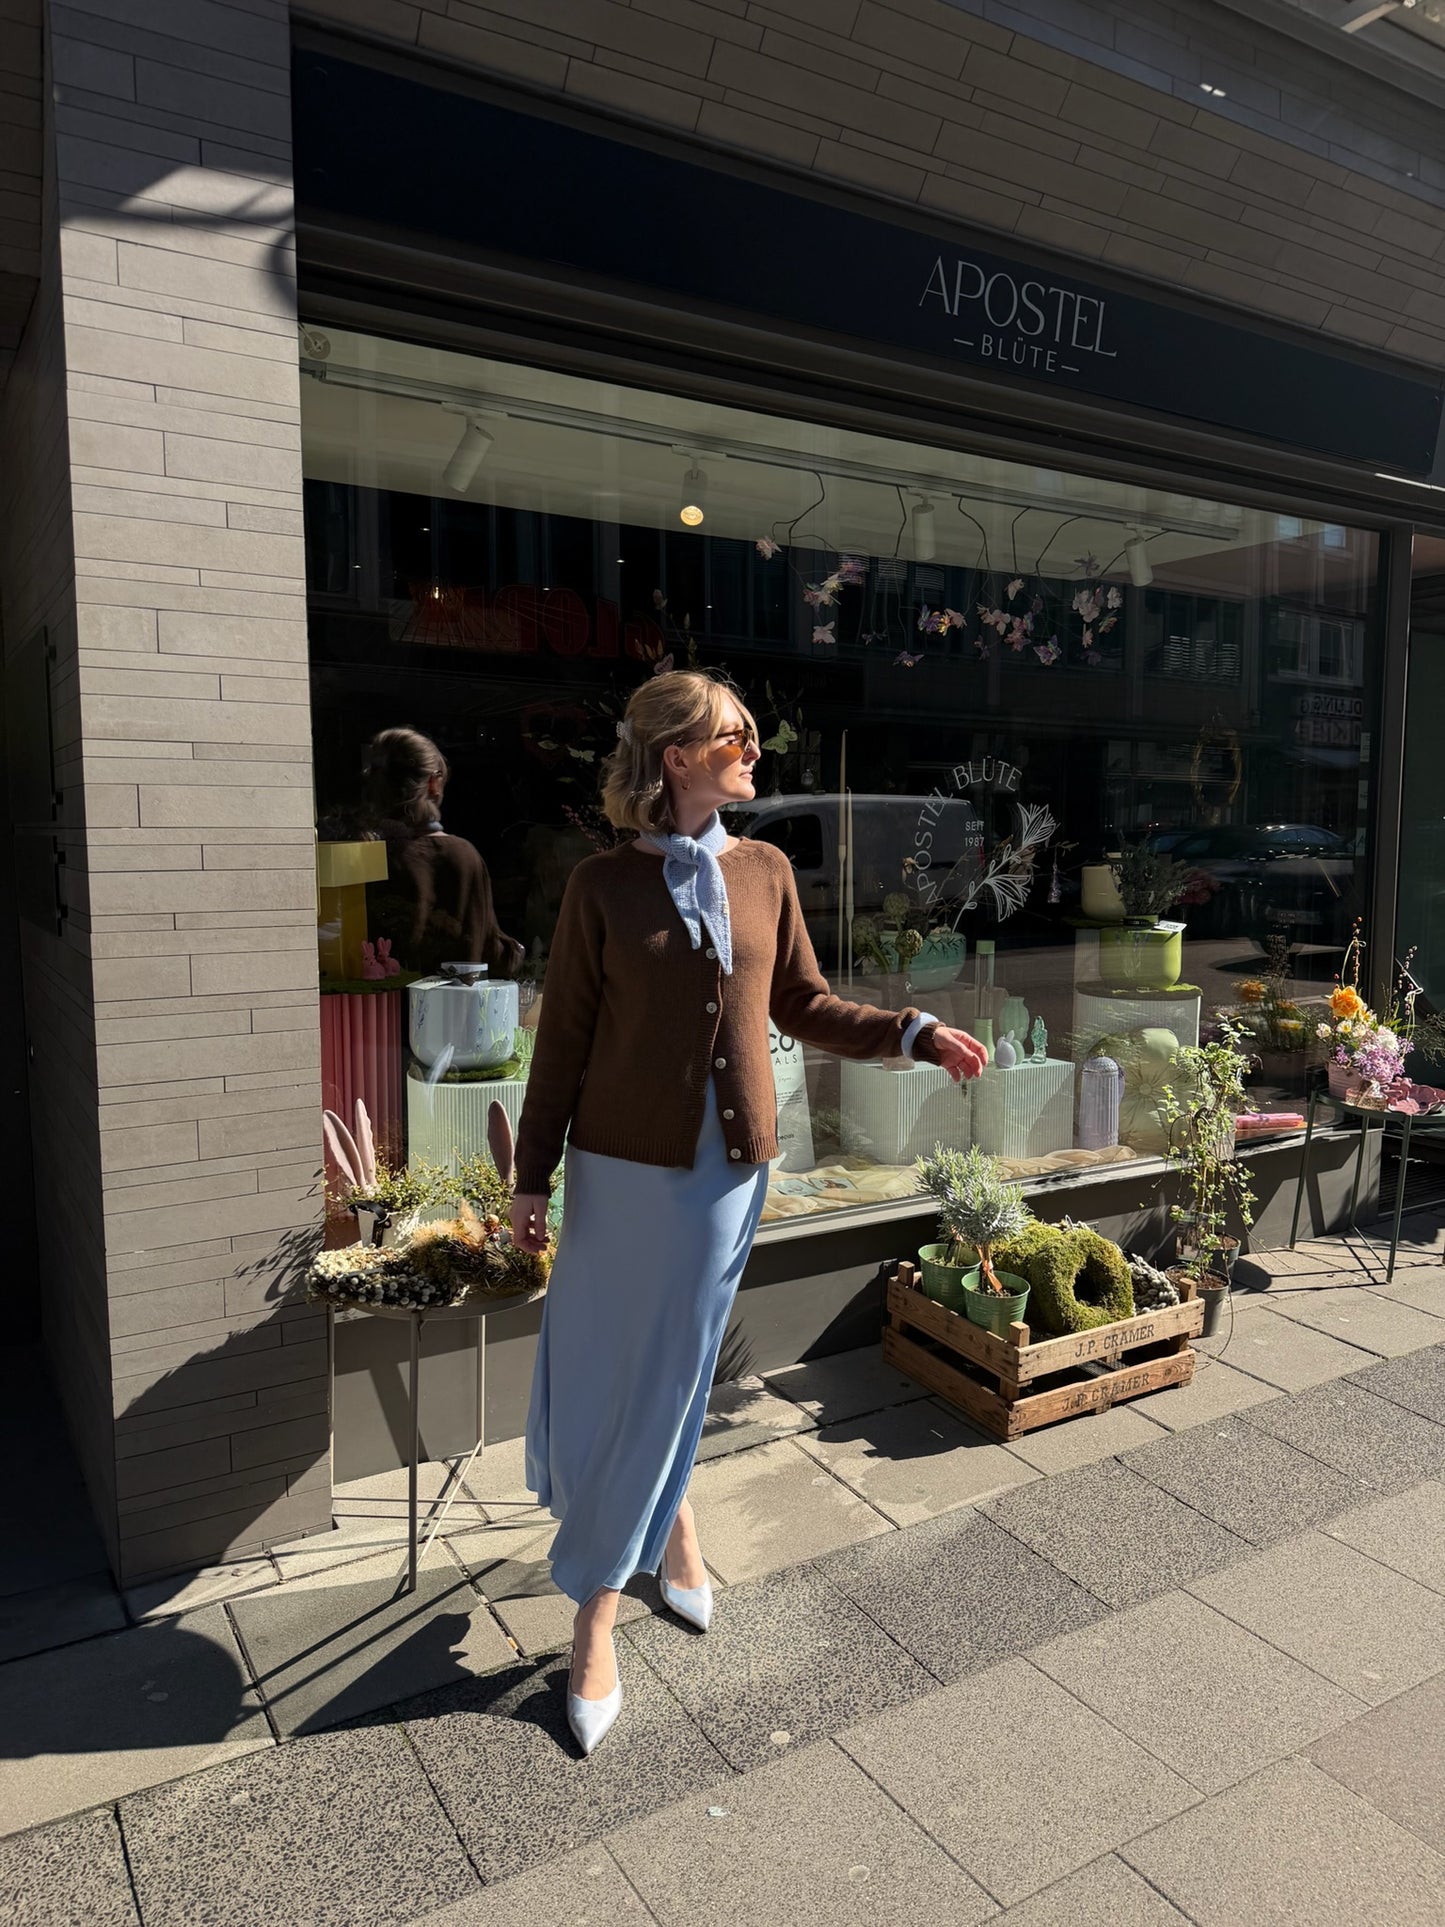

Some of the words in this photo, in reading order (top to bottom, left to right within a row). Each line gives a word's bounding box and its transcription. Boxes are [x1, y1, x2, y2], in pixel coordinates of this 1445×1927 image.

[918, 255, 1118, 358] APOSTEL
[980, 333, 1058, 373] BLÜTE
[914, 786, 954, 905] APOSTEL
[952, 755, 1023, 792] BLÜTE
[964, 836, 985, 847] 1987
[1075, 1341, 1098, 1358] J.P.
[1104, 1324, 1155, 1350] CRAMER
[1092, 1373, 1150, 1401] CRAMER
